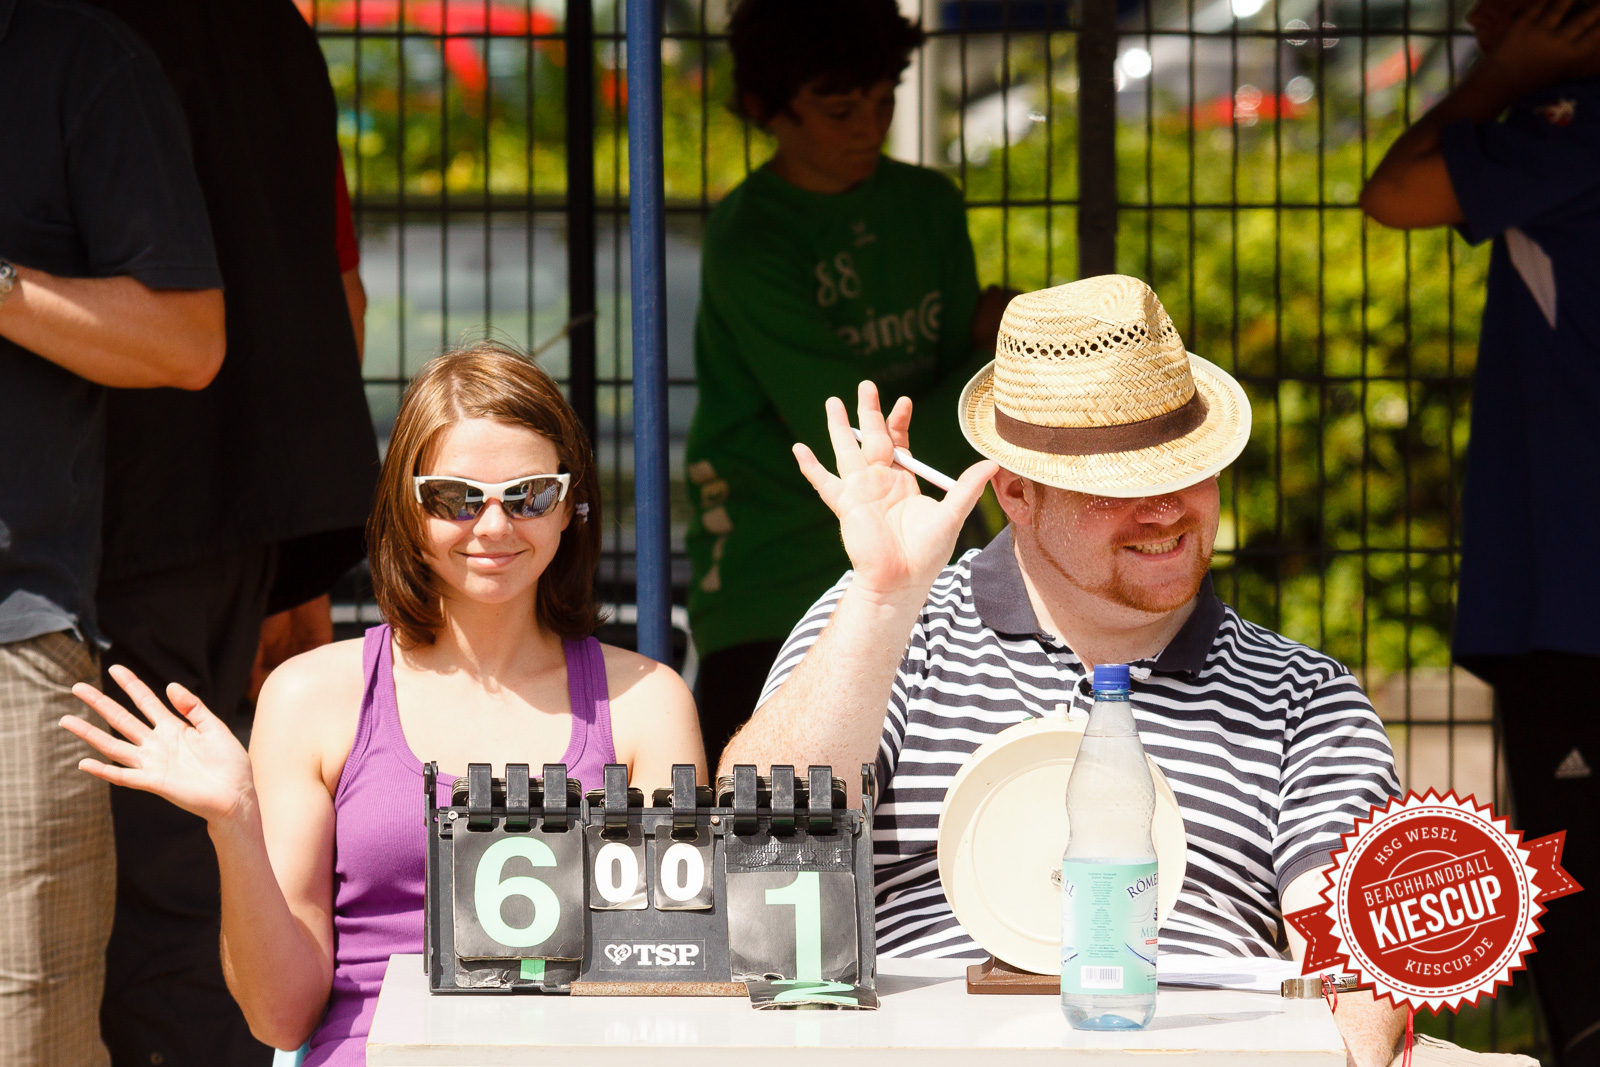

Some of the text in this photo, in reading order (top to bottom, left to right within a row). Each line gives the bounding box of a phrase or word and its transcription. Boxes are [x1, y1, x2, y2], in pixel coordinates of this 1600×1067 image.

[815, 250, 862, 308] 88
[473, 835, 562, 948] 6
[764, 870, 822, 981] 1
[1126, 872, 1158, 899] RÖME
